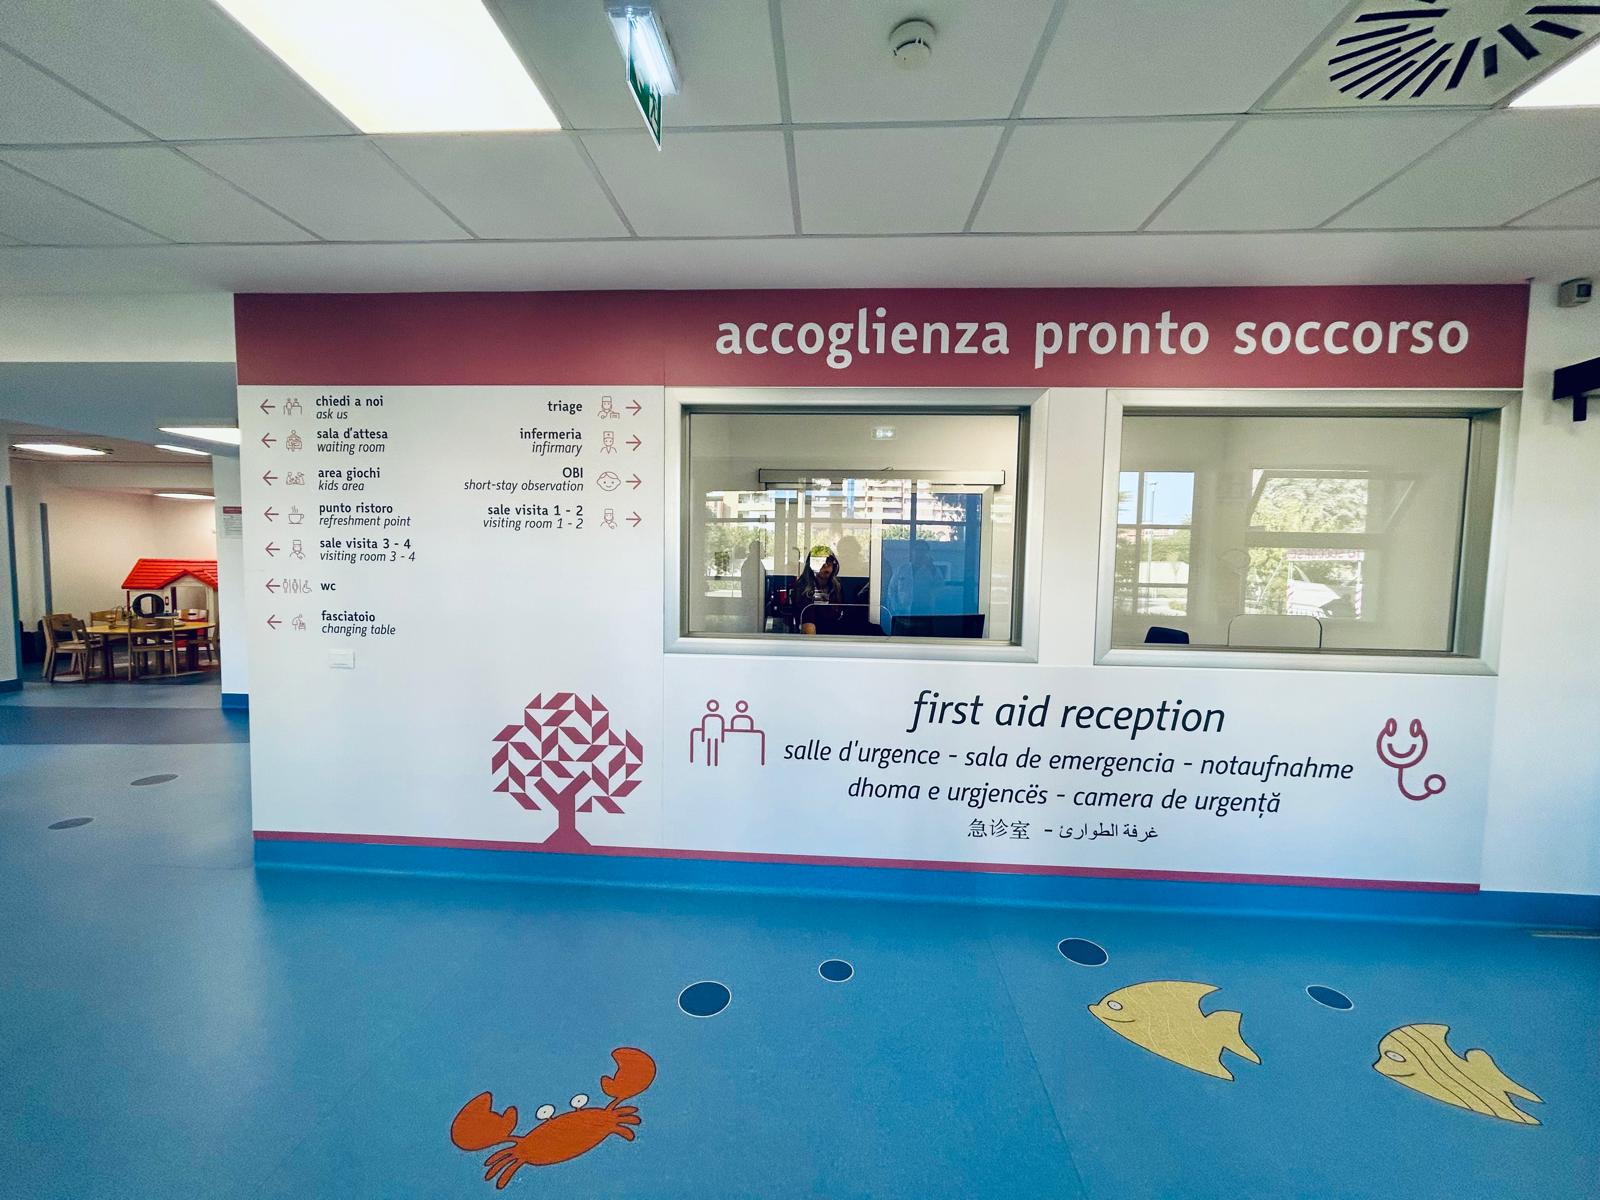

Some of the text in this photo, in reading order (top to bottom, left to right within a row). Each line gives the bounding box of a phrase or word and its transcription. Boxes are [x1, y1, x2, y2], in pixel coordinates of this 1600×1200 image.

[715, 306, 1469, 370] accoglienza pronto soccorso
[315, 394, 384, 407] chiedi a noi
[546, 399, 583, 415] triage
[315, 407, 349, 420] ask us
[316, 426, 389, 440] sala d'attesa
[519, 427, 582, 440] infermeria
[316, 440, 386, 456] waiting room
[532, 441, 583, 457] infirmary
[317, 466, 381, 482] area giochi
[562, 466, 584, 479] OBI
[317, 479, 365, 491] kids area
[463, 478, 584, 494] short-stay observation
[319, 502, 394, 516] punto ristoro
[487, 503, 511, 516] sale
[514, 503, 549, 516] visita
[553, 504, 561, 516] 1
[575, 504, 584, 517] 2
[319, 514, 412, 530] refreshment point
[483, 516, 521, 532] visiting
[524, 520, 553, 529] room
[556, 517, 563, 529] 1
[575, 517, 584, 530] 2
[319, 537, 342, 549] sale
[345, 537, 378, 549] visita
[382, 537, 390, 550] 3
[403, 538, 412, 550] 4
[319, 549, 357, 565] visiting
[359, 553, 387, 562] room
[389, 550, 397, 562] 3
[408, 551, 416, 562] 4
[320, 582, 337, 591] wc
[320, 609, 376, 623] fasciatoio
[321, 622, 396, 638] changing table
[905, 689, 1225, 741] first aid reception
[783, 739, 832, 761] salle
[838, 739, 941, 770] d'urgence
[964, 745, 1009, 768] sala
[1015, 746, 1042, 769] de
[1048, 752, 1175, 778] emergencia
[1200, 754, 1354, 783] notaufnahme
[848, 776, 921, 800] dhoma
[928, 785, 941, 801] e
[947, 782, 1049, 810] urgjencës
[1073, 791, 1154, 809] camera
[1161, 788, 1188, 810] de
[1194, 791, 1281, 819] urgență
[967, 817, 1031, 840] 急诊室
[1122, 823, 1159, 843] غرفة
